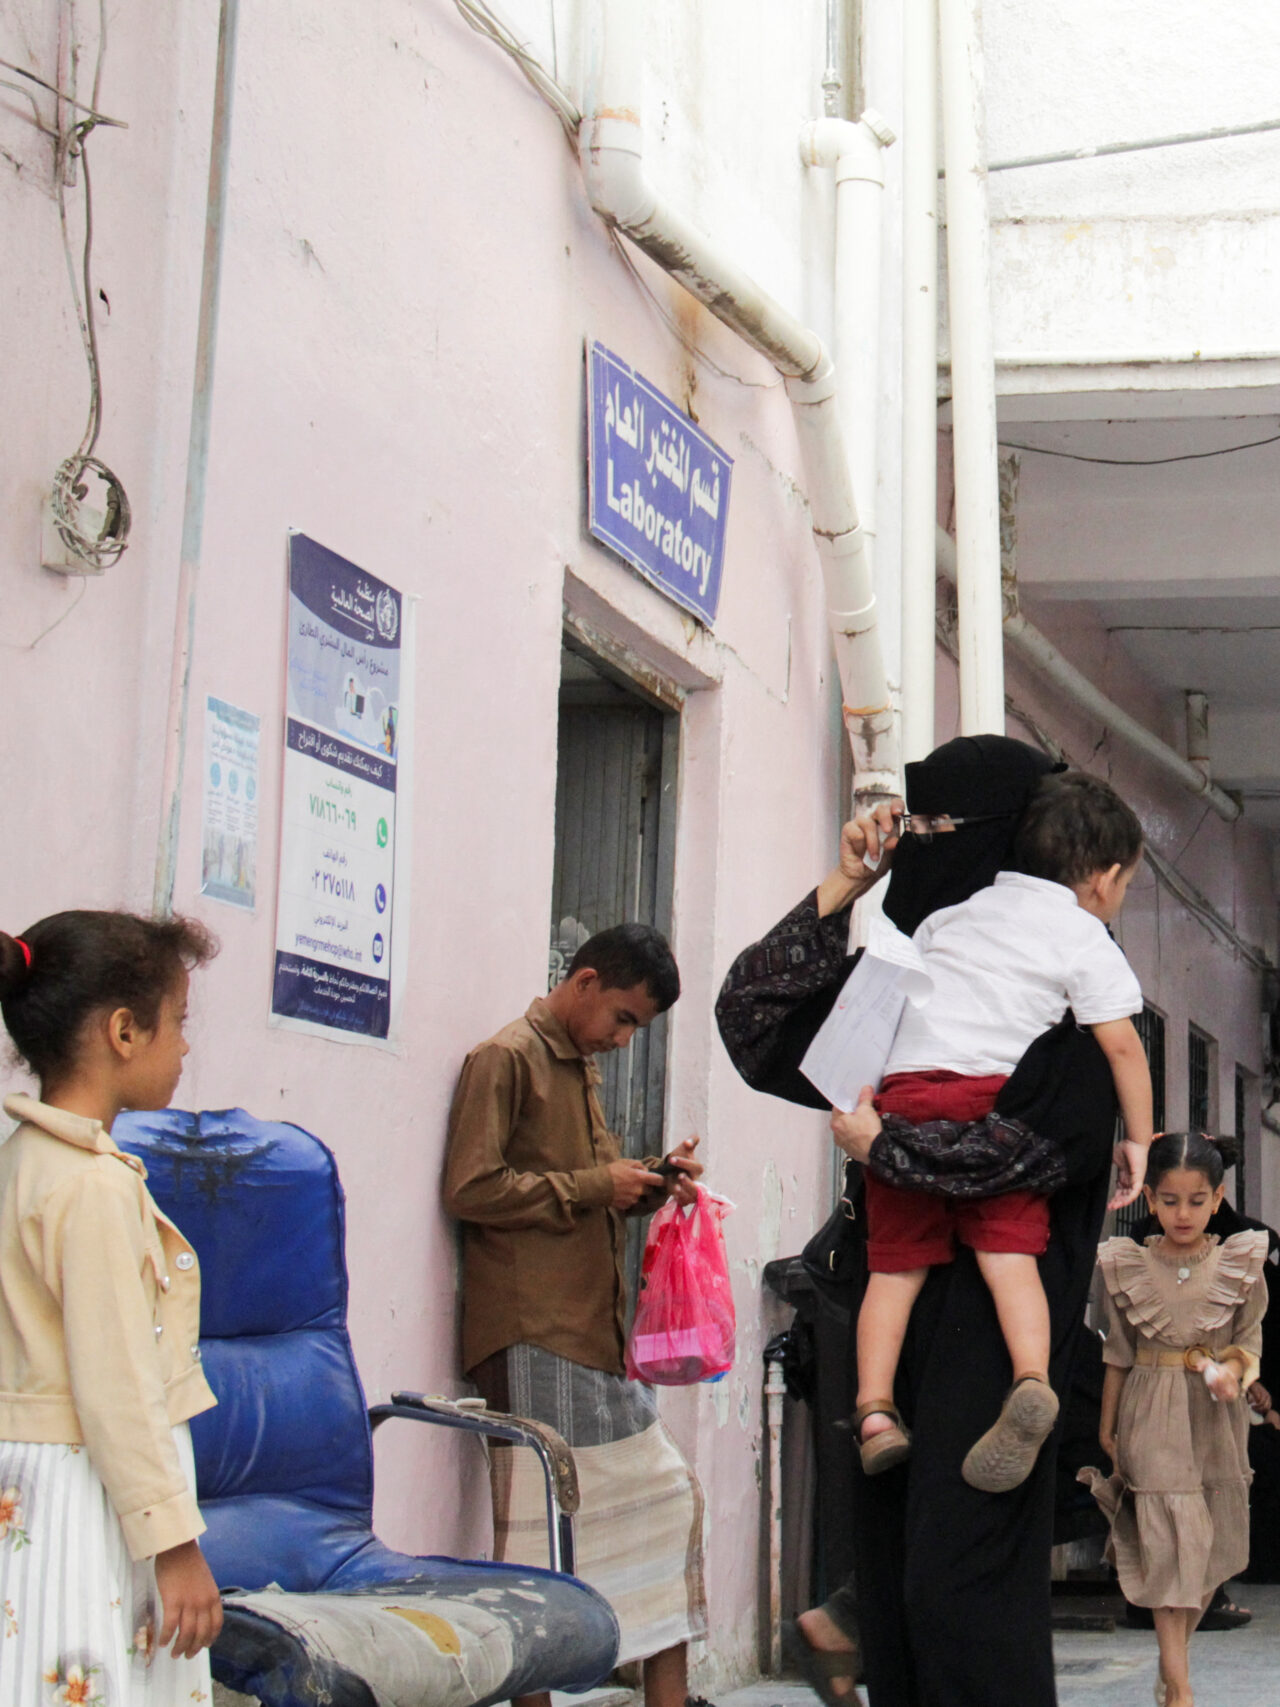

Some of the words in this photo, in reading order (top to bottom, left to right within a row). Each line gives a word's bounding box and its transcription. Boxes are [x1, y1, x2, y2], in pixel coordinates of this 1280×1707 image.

[604, 382, 645, 453] العام
[645, 419, 690, 493] المختبر
[689, 459, 721, 520] قسم
[607, 458, 713, 597] Laboratory
[331, 585, 354, 611] العالمية
[354, 598, 375, 623] الصحة
[341, 641, 355, 658] المال
[369, 658, 389, 675] مشروع
[320, 742, 338, 758] شكوى
[370, 763, 383, 779] كيف
[309, 793, 357, 832] ٧١٨٦٦٠٠٦٩
